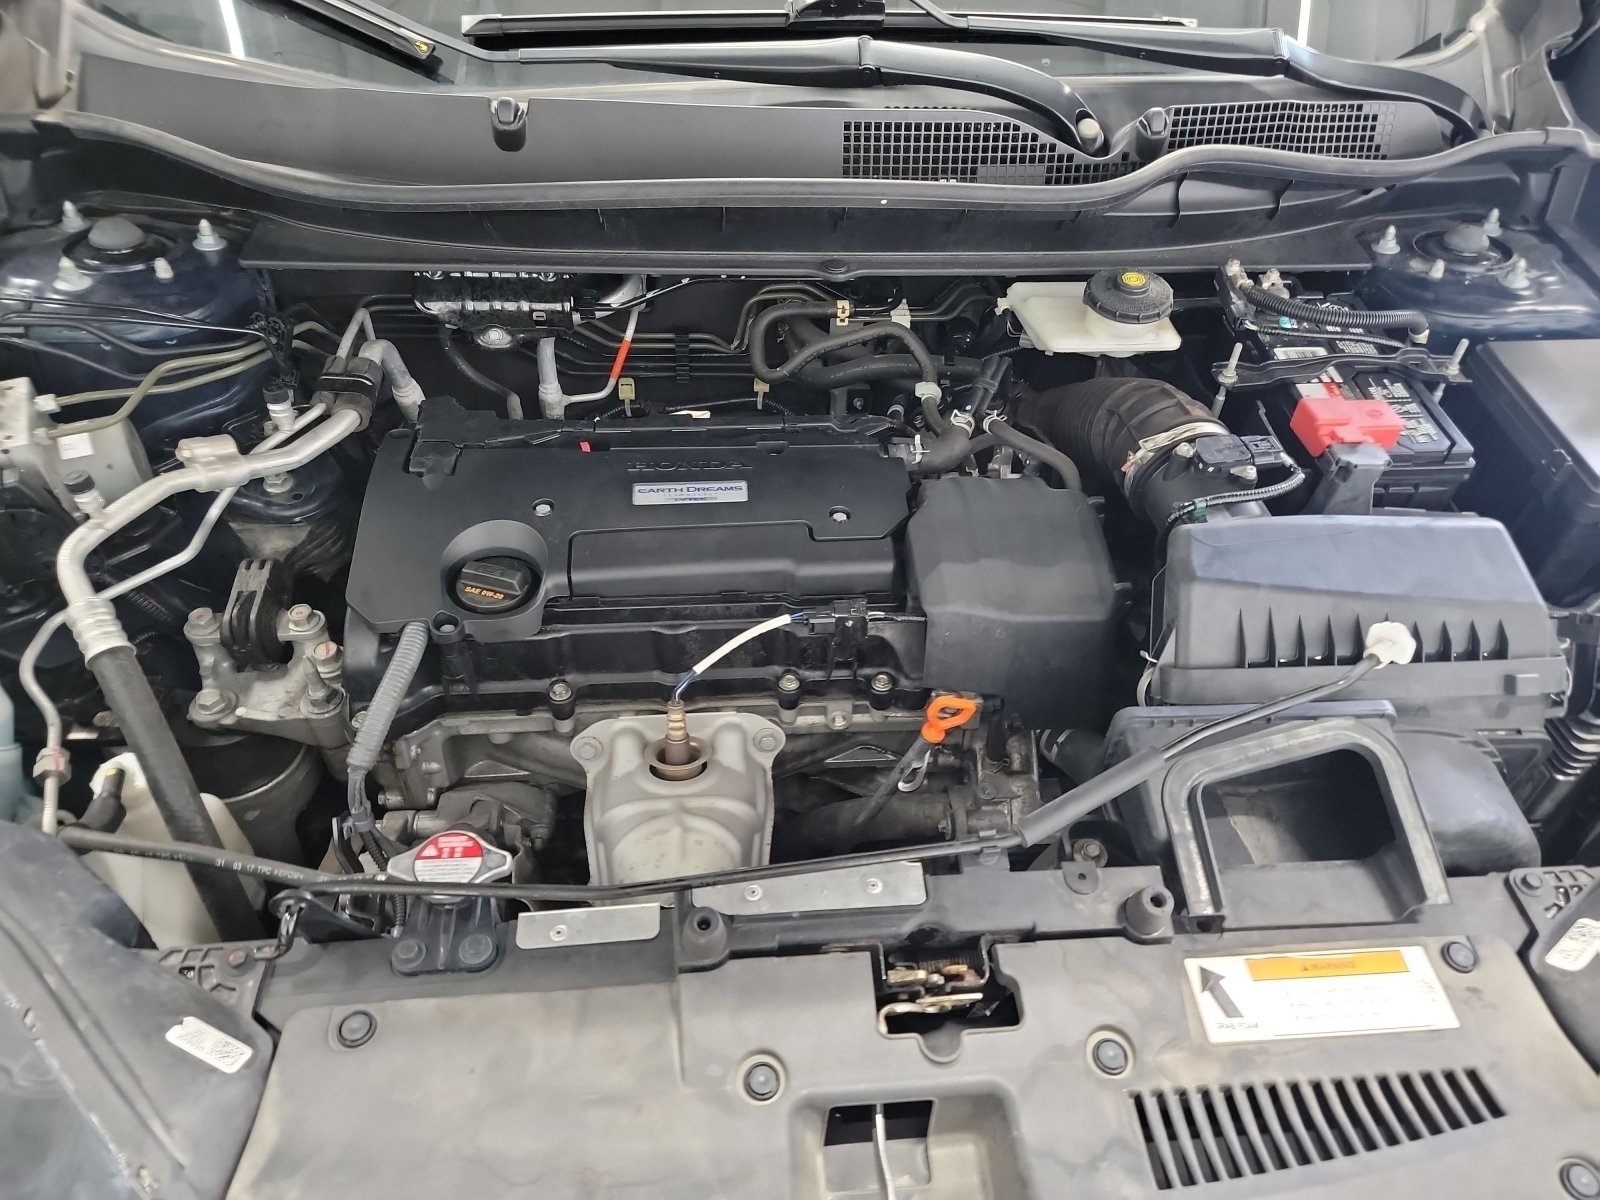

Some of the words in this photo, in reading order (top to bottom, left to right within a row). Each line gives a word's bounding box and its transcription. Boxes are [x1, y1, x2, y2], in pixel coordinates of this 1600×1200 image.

[627, 461, 752, 471] HONDA
[686, 485, 743, 493] DREAMS
[464, 586, 482, 595] SAE
[481, 590, 505, 600] 0W-20
